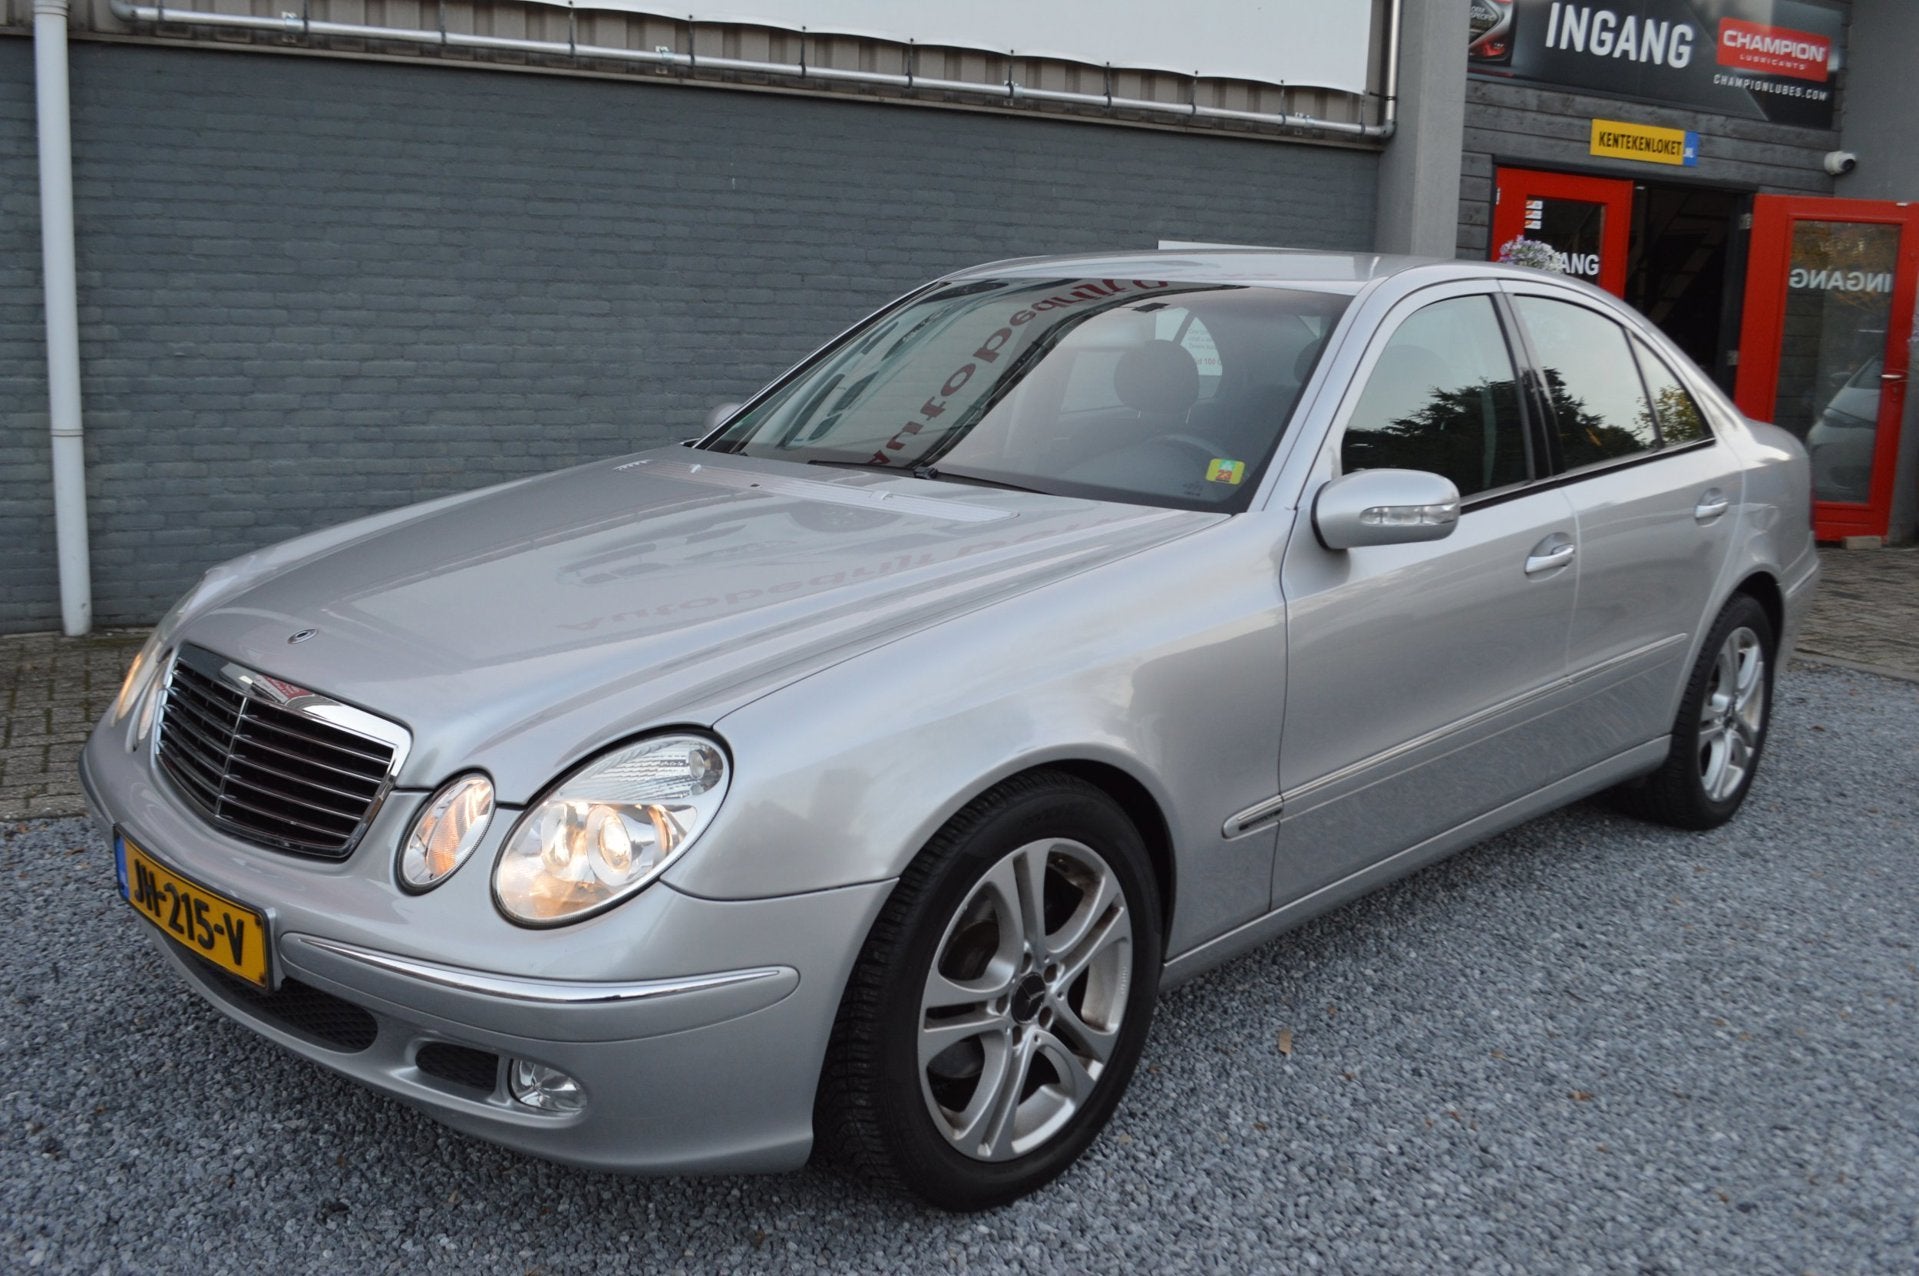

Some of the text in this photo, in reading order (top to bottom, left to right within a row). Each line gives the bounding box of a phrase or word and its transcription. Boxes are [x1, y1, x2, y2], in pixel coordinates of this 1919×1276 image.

[1545, 2, 1694, 69] INGANG
[1723, 29, 1825, 62] CHAMPION
[1713, 73, 1828, 101] CHAMPIONLUBES.COM
[1598, 131, 1682, 156] KENTEKENLOKET
[134, 858, 244, 967] JH-215-V
